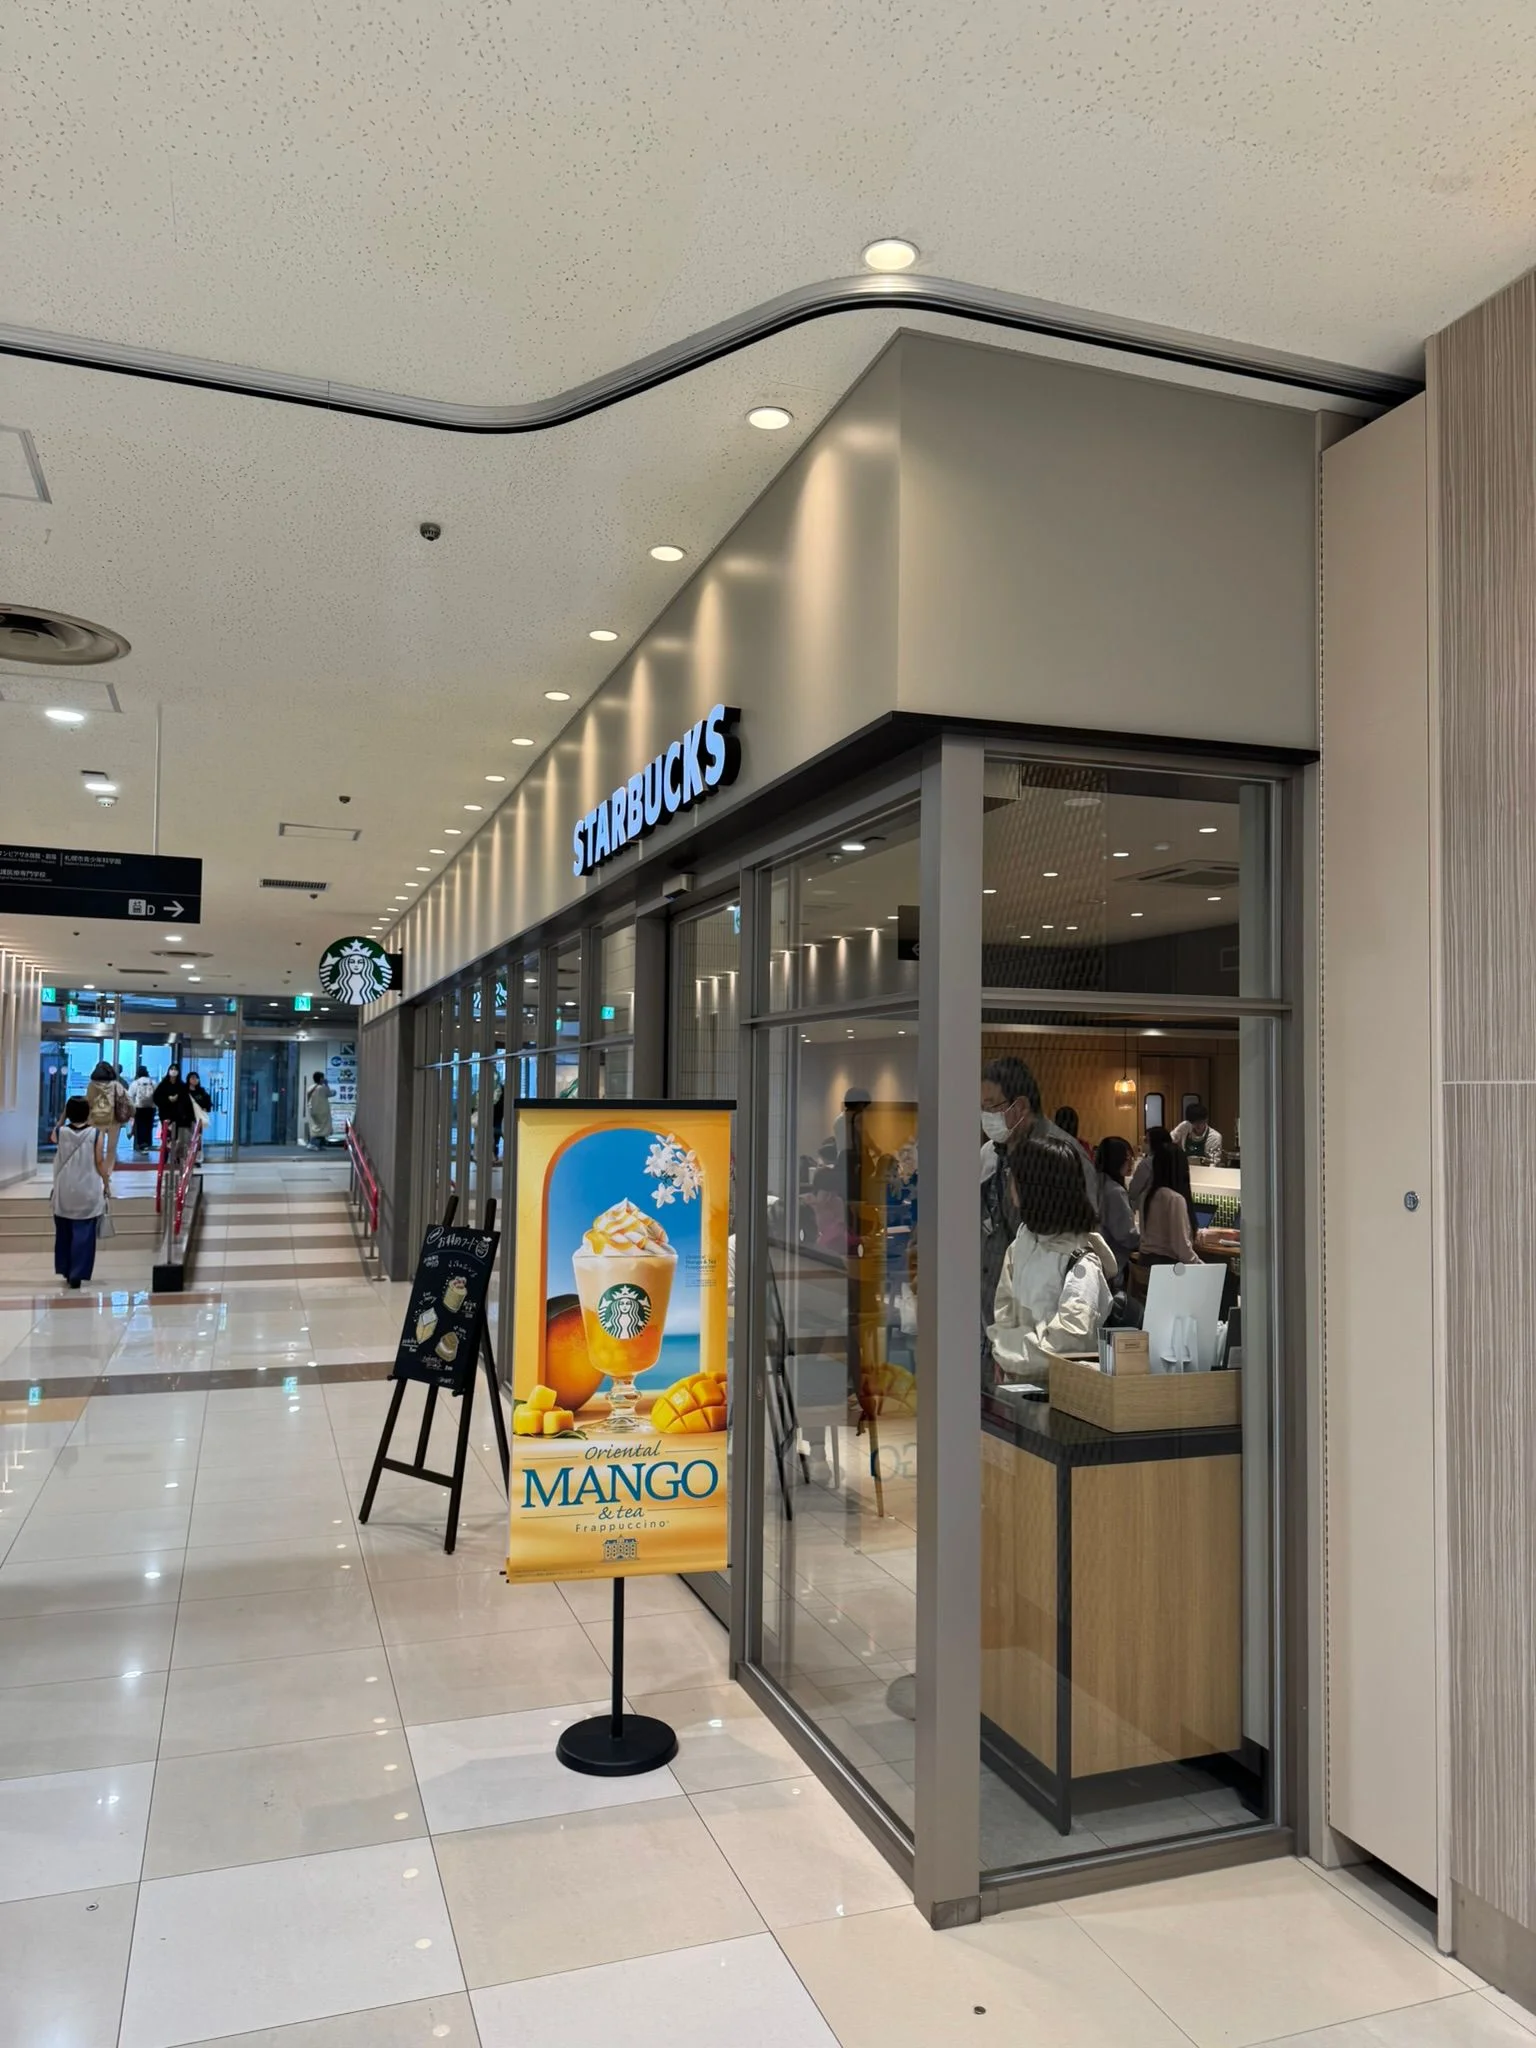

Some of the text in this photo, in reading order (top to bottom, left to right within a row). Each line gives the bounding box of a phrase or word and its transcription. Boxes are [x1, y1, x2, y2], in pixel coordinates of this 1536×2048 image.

[573, 703, 728, 877] STARBUCKS
[584, 1440, 662, 1460] Oriental
[521, 1459, 719, 1508] MANGO
[616, 1505, 644, 1519] tea
